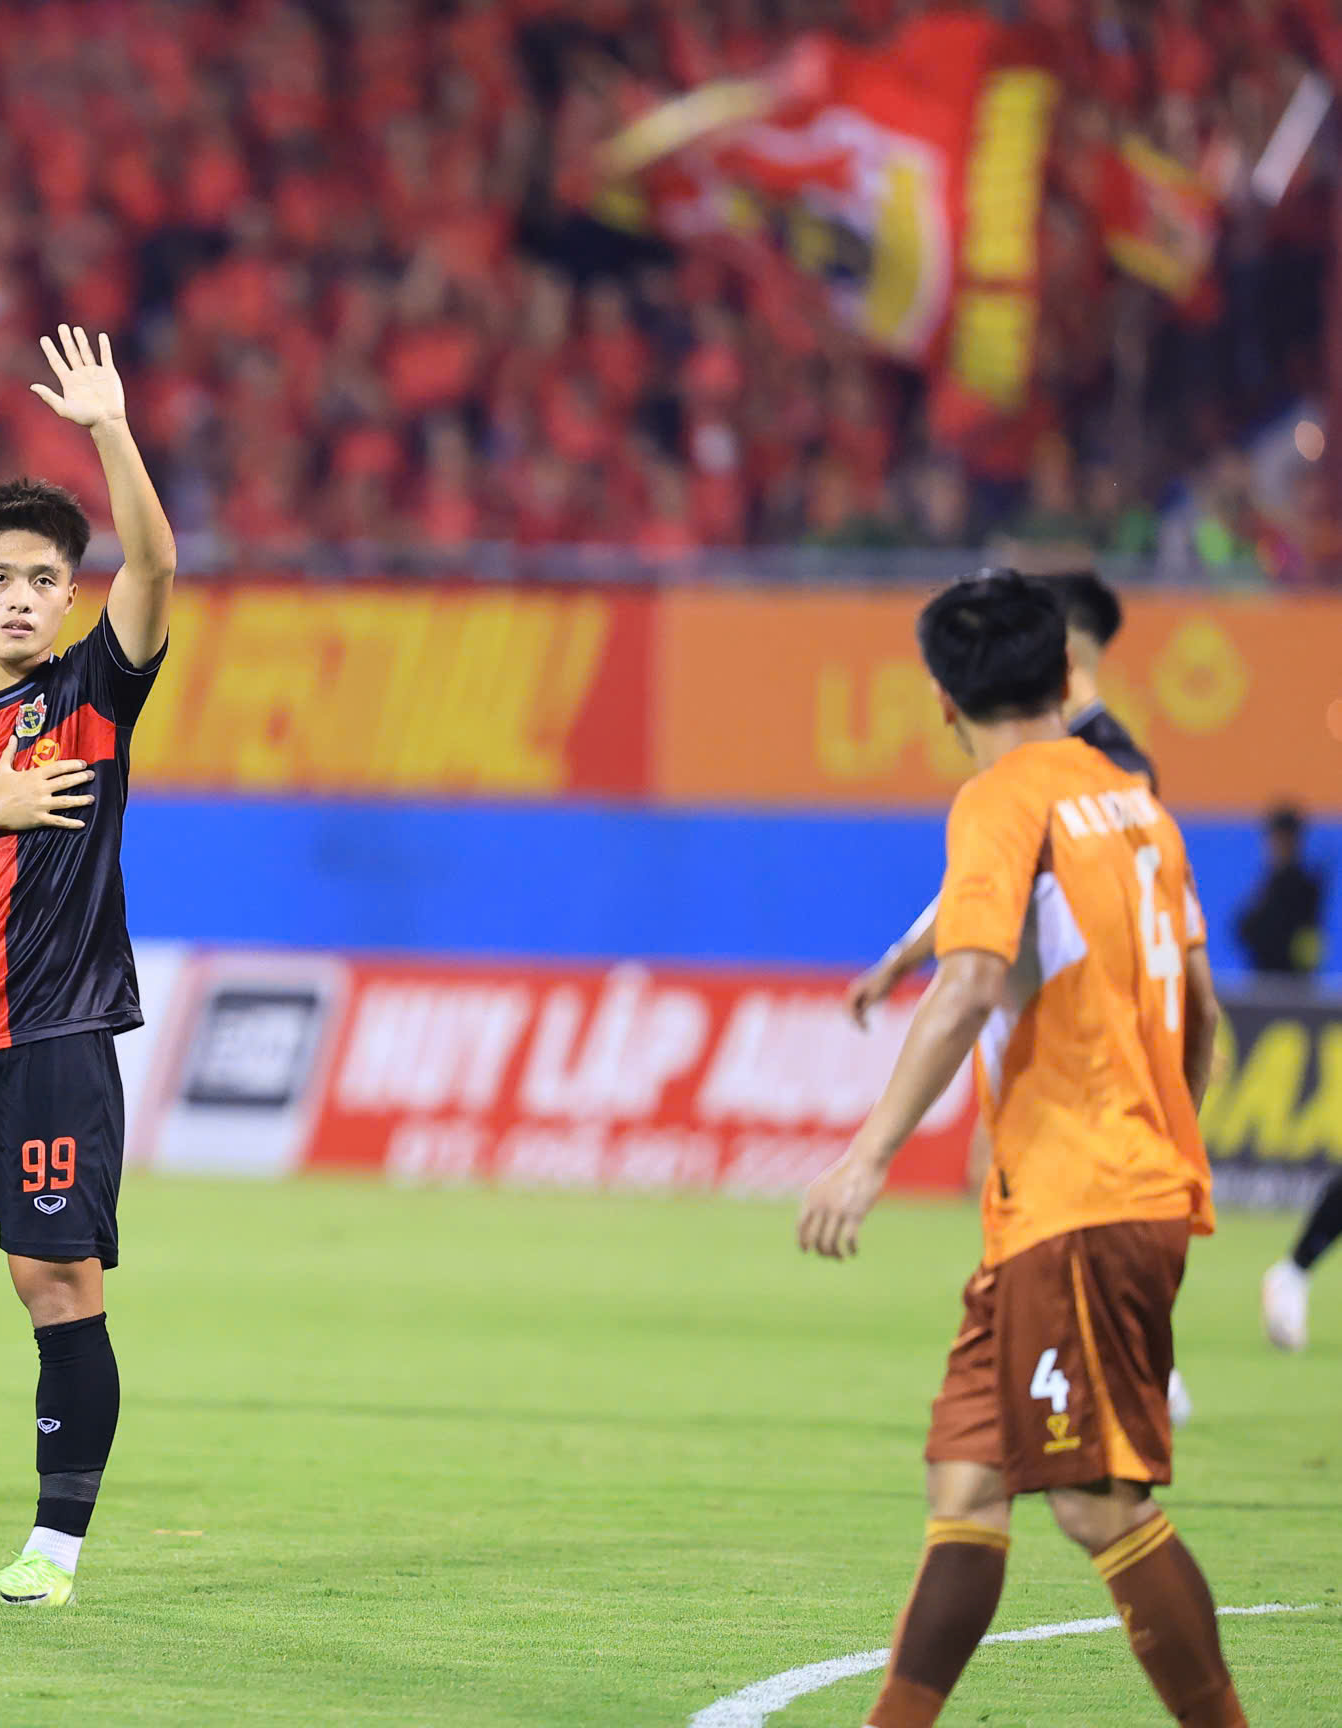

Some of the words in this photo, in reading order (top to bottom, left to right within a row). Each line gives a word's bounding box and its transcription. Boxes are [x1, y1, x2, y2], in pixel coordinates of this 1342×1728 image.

[1133, 845, 1181, 1032] 4
[21, 1136, 76, 1192] 99
[1030, 1348, 1070, 1413] 4
